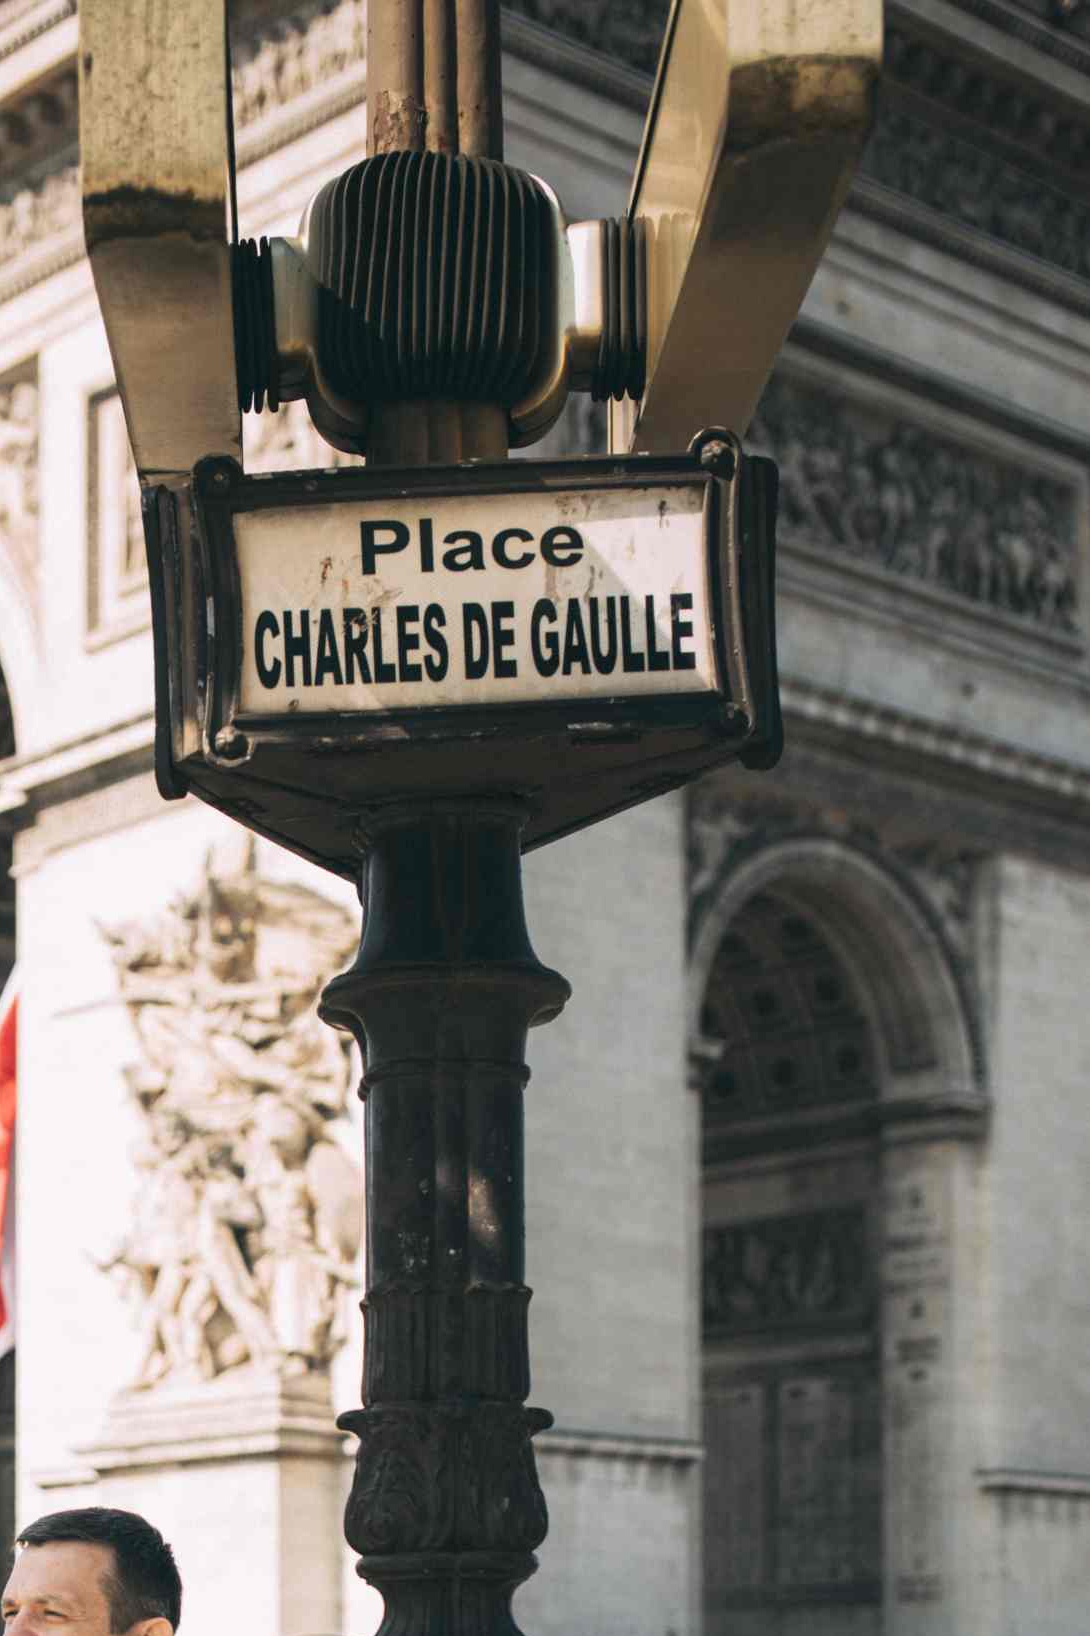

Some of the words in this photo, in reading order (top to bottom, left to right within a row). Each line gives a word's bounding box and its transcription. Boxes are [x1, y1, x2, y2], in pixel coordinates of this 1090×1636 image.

[361, 518, 584, 574] Place
[255, 603, 449, 689] CHARLES
[462, 600, 517, 680] DE
[531, 592, 697, 677] GAULLE
